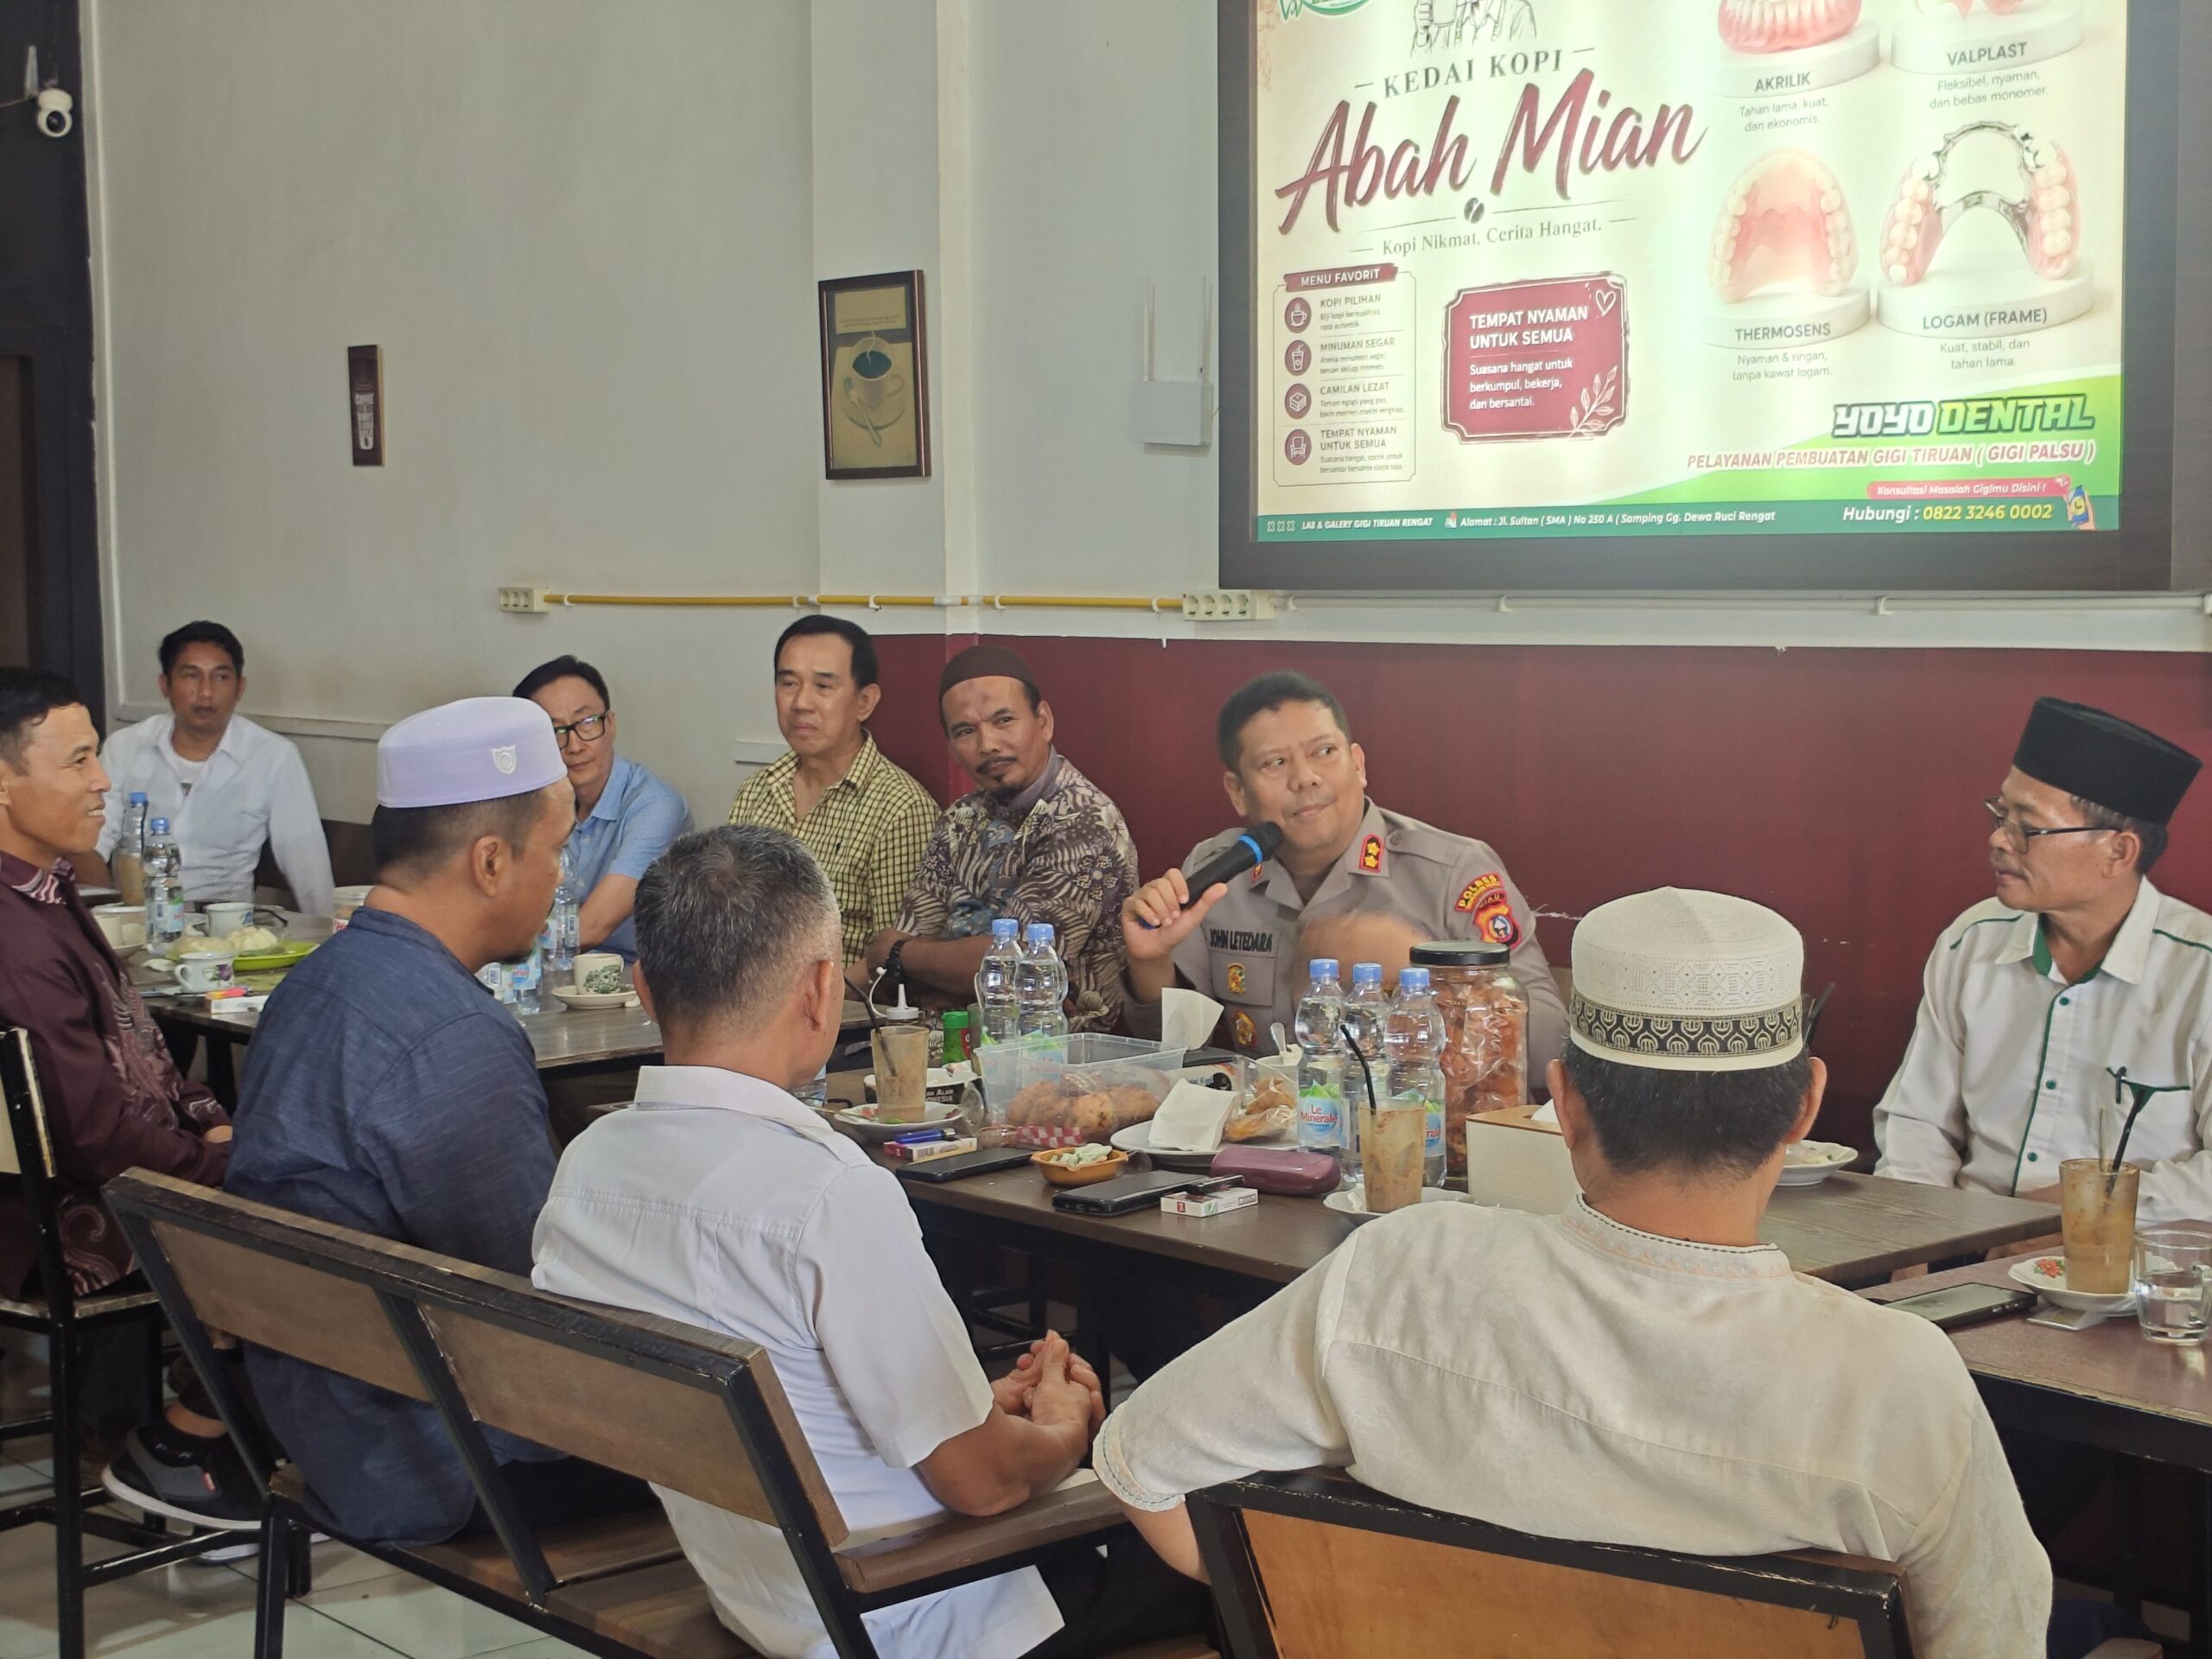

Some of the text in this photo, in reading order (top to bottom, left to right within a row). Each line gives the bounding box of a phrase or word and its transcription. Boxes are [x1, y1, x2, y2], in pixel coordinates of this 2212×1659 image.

[1946, 42, 2028, 67] VALPLAST
[1382, 49, 1562, 99] KEDAI KOPI
[1754, 71, 1811, 92] AKRILIK
[1929, 97, 1950, 110] dan
[1953, 92, 1988, 107] bebas
[1739, 105, 1770, 119] Tahan
[1744, 119, 1765, 132] dan
[1274, 67, 1708, 235] Abah Mian
[1382, 238, 1417, 257] Kopi
[1486, 225, 1534, 243] Cerita
[1300, 268, 1381, 287] MENU FAVORIT
[1320, 294, 1382, 308] KOPI PILIHAN
[1470, 305, 1588, 329] TEMPAT NYAMAN
[1923, 308, 2048, 330] LOGAM (FRAME)
[1470, 327, 1573, 350] UNTUK SEMUA
[1735, 322, 1831, 341] THERMOSENS
[1320, 337, 1395, 353] MINUMAN SEGAR
[2008, 339, 2031, 351] dan
[1470, 358, 1573, 375] Suasana hangat untuk
[1737, 353, 1779, 365] Nyaman
[1950, 358, 1983, 370] tahan
[1732, 371, 1762, 383] tanpa
[1764, 368, 1795, 380] kawat
[1319, 382, 1389, 395] CAMILAN LEZAT
[1470, 377, 1563, 393] berkumpul, bekerja,
[1470, 398, 1487, 410] dan
[1833, 394, 2095, 438] YOYO DENTAL
[1320, 426, 1397, 439] TEMPAT NYAMAN
[1320, 439, 1386, 451] UNTUK SEMUA
[1687, 452, 1772, 469] PELAYANAN
[1776, 449, 1868, 467] PEMBUATAN
[1872, 448, 1906, 465] GIGI
[1912, 447, 1972, 463] TIRUAN
[1987, 445, 2023, 461] GIGI
[2030, 442, 2083, 460] PALSU
[1877, 484, 1927, 496] Konsultasi
[1929, 484, 1969, 495] Masalah
[1973, 483, 2009, 496] Gigimu
[2011, 482, 2040, 493] Disini
[1459, 517, 1492, 527] Alamat
[1514, 515, 1538, 526] Sultan
[1546, 516, 1567, 525] SMA
[1573, 515, 1586, 524] No
[1588, 514, 1605, 524] 250
[1605, 514, 1614, 524] A
[1622, 512, 1663, 526] Samping
[1684, 512, 1713, 523] Dewa
[1714, 511, 1737, 522] Ruci
[1738, 510, 1776, 524] Rengat
[1842, 505, 1910, 524] Hubungi
[1923, 505, 1961, 520] 0822
[1965, 505, 2005, 520] 3246
[2010, 504, 2053, 519] 0002
[1354, 519, 1371, 528] GIGI
[1372, 518, 1401, 528] TIRUAN
[1402, 518, 1433, 527] RENGAT
[1210, 927, 1229, 950] JOHN
[1300, 1111, 1338, 1123] Minerale
[1311, 1103, 1322, 1115] Le
